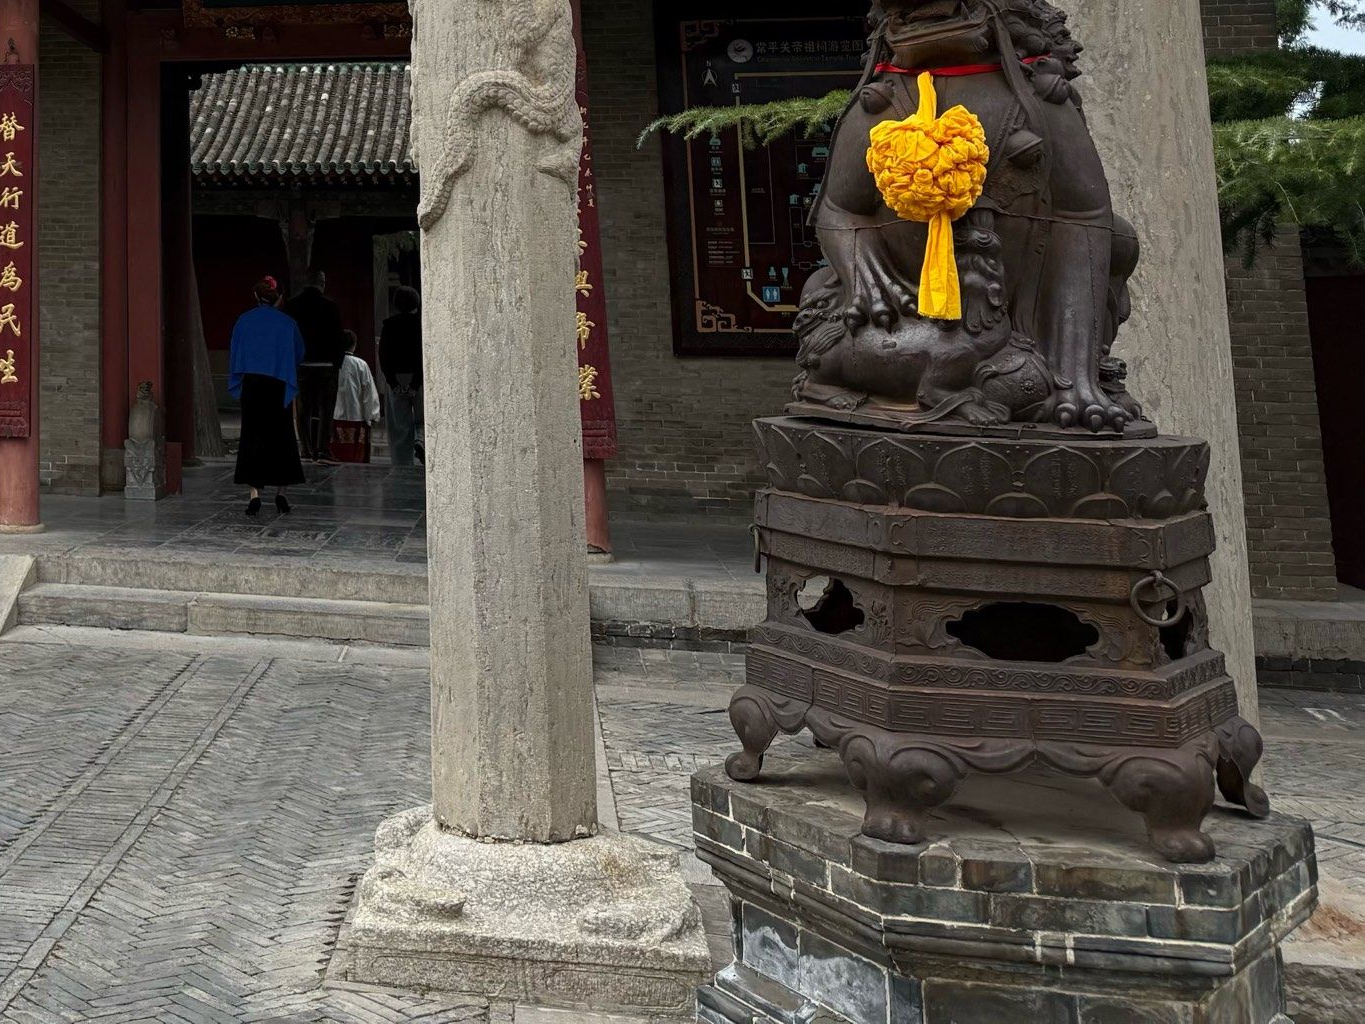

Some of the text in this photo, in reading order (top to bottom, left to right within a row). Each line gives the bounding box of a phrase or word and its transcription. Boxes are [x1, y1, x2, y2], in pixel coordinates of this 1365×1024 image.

[757, 40, 864, 53] 常平关帝祖祠游览图
